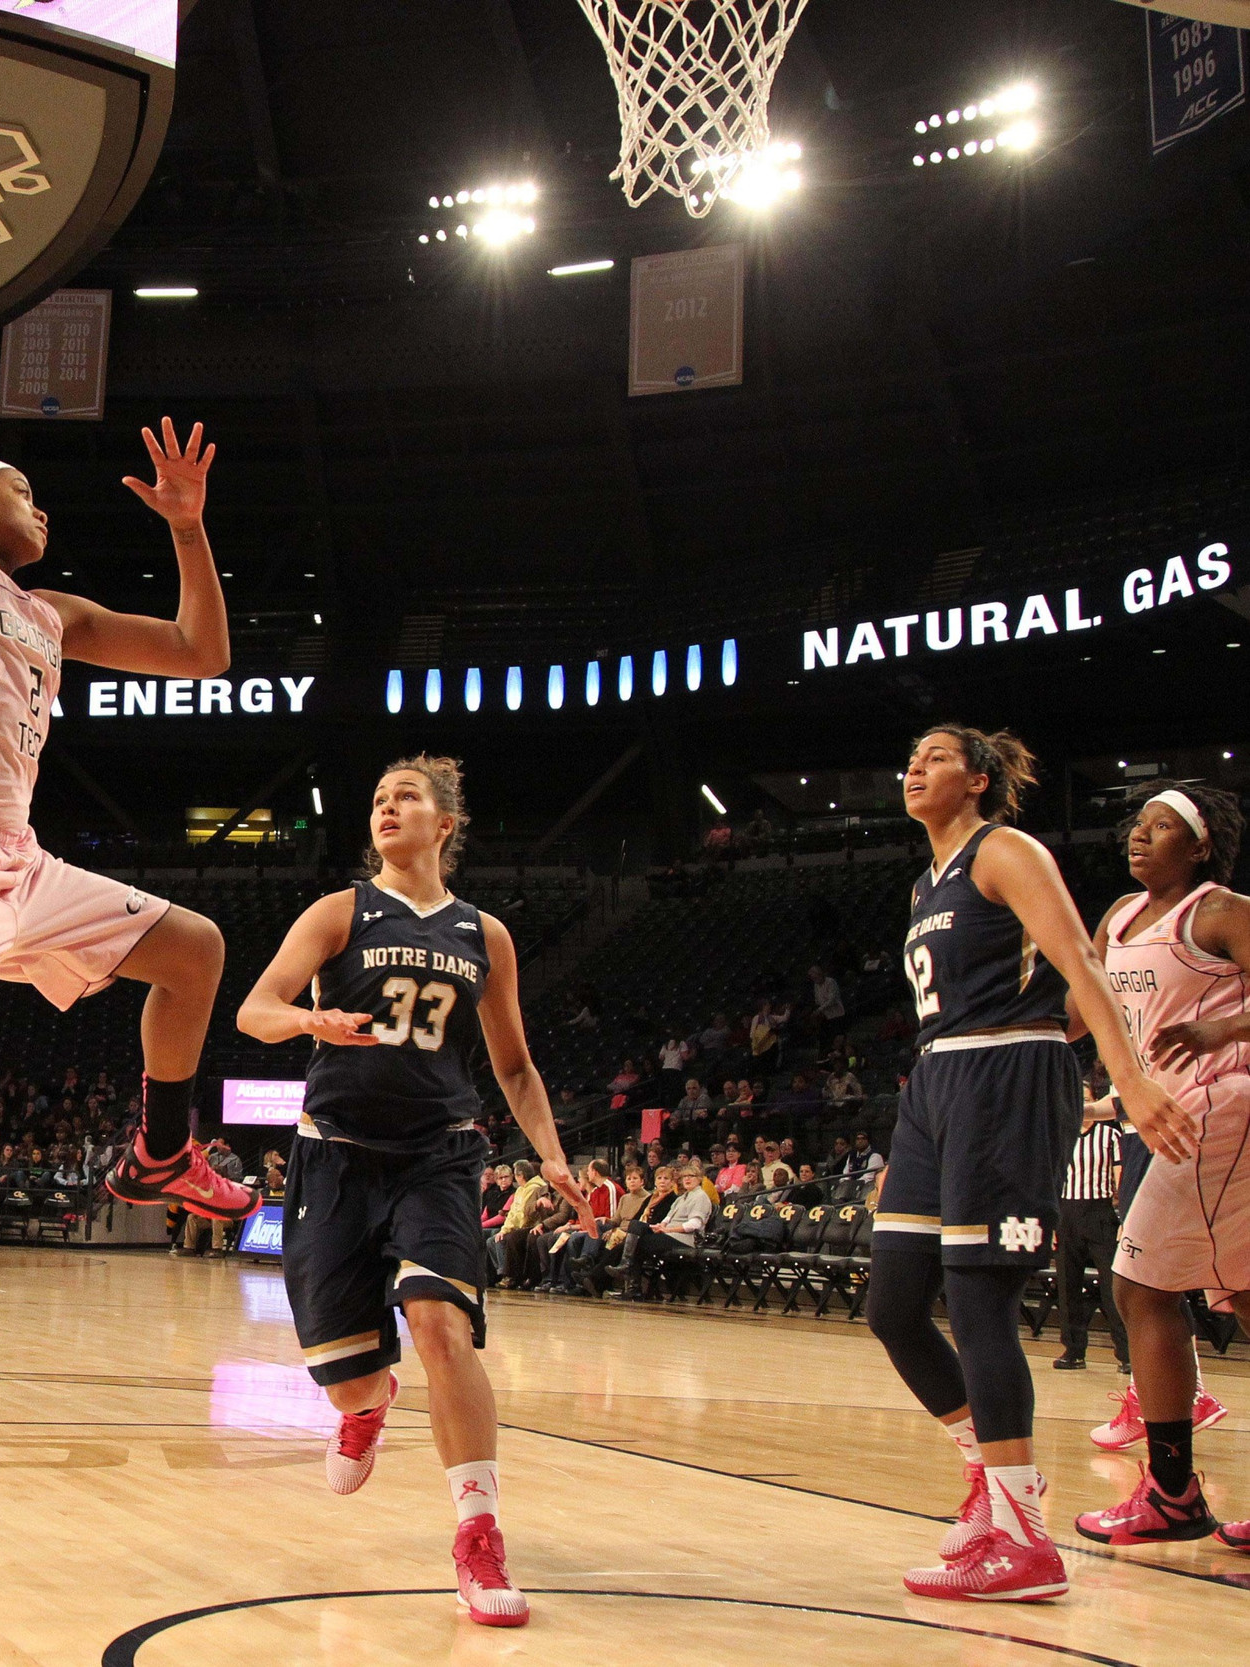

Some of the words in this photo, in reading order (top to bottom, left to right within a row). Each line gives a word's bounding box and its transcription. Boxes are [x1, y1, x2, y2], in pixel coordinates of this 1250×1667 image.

[1173, 49, 1217, 98] 1996
[1178, 87, 1220, 127] ACC
[663, 296, 708, 322] 2012
[62, 323, 91, 337] 2010
[61, 338, 87, 351] 2011
[20, 352, 50, 366] 2007
[60, 353, 88, 366] 2013
[19, 366, 50, 380] 2008
[59, 367, 87, 381] 2014
[18, 381, 49, 395] 2009
[1123, 542, 1232, 615] GAS
[29, 664, 45, 718] 2
[88, 675, 316, 718] ENERGY
[918, 911, 955, 938] DAME
[361, 946, 428, 970] NOTRE
[432, 951, 478, 984] DAME
[1106, 968, 1158, 993] ORGIA
[370, 976, 458, 1053] 33
[236, 1083, 282, 1098] Atlanta
[253, 1106, 263, 1119] A
